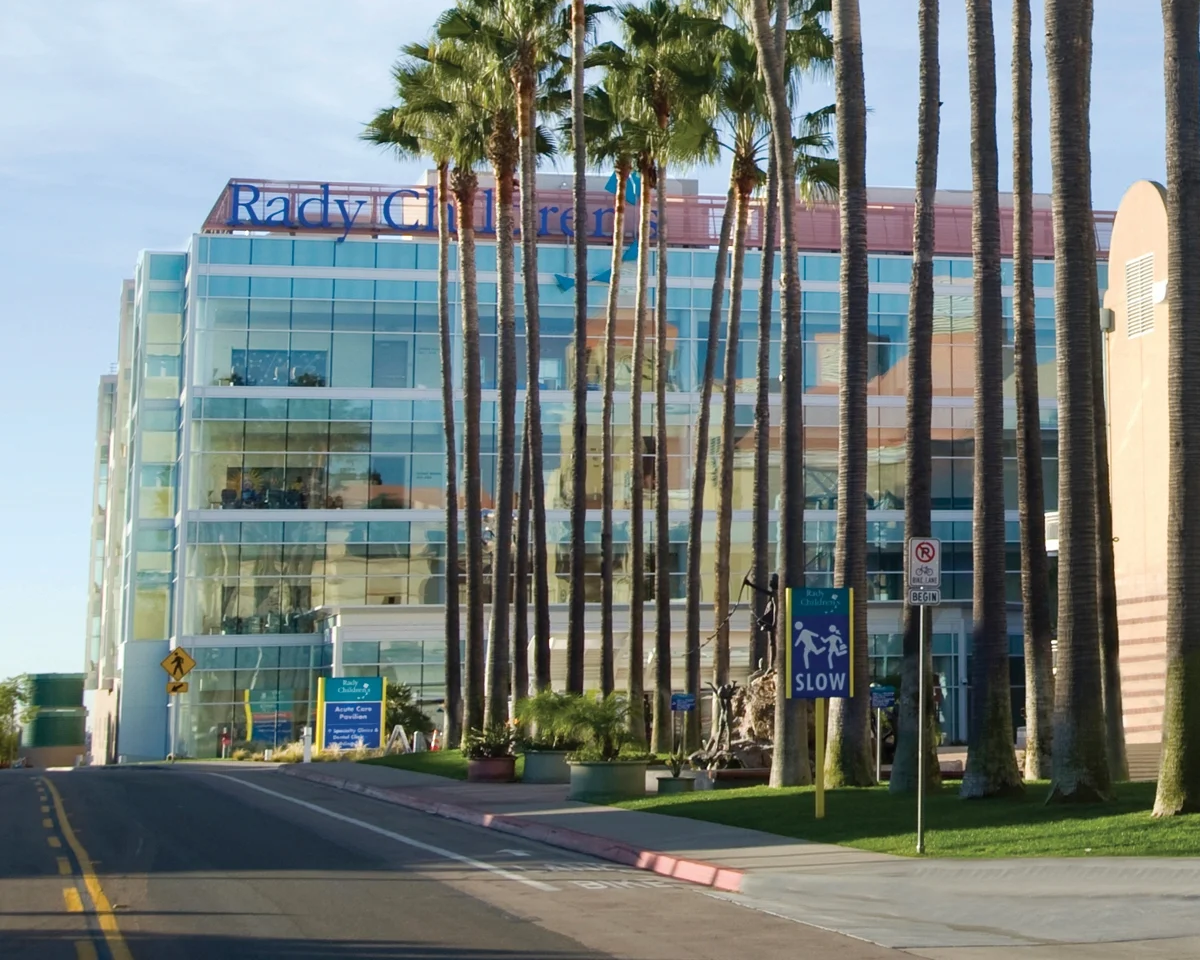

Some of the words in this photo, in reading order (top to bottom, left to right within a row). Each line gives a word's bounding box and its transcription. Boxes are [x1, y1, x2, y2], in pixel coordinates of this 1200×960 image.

[228, 183, 367, 243] Rady
[806, 589, 824, 598] Rady
[912, 592, 937, 602] BEGIN
[342, 680, 358, 688] Rady
[795, 672, 846, 692] SLOW
[569, 880, 673, 889] BIKE
